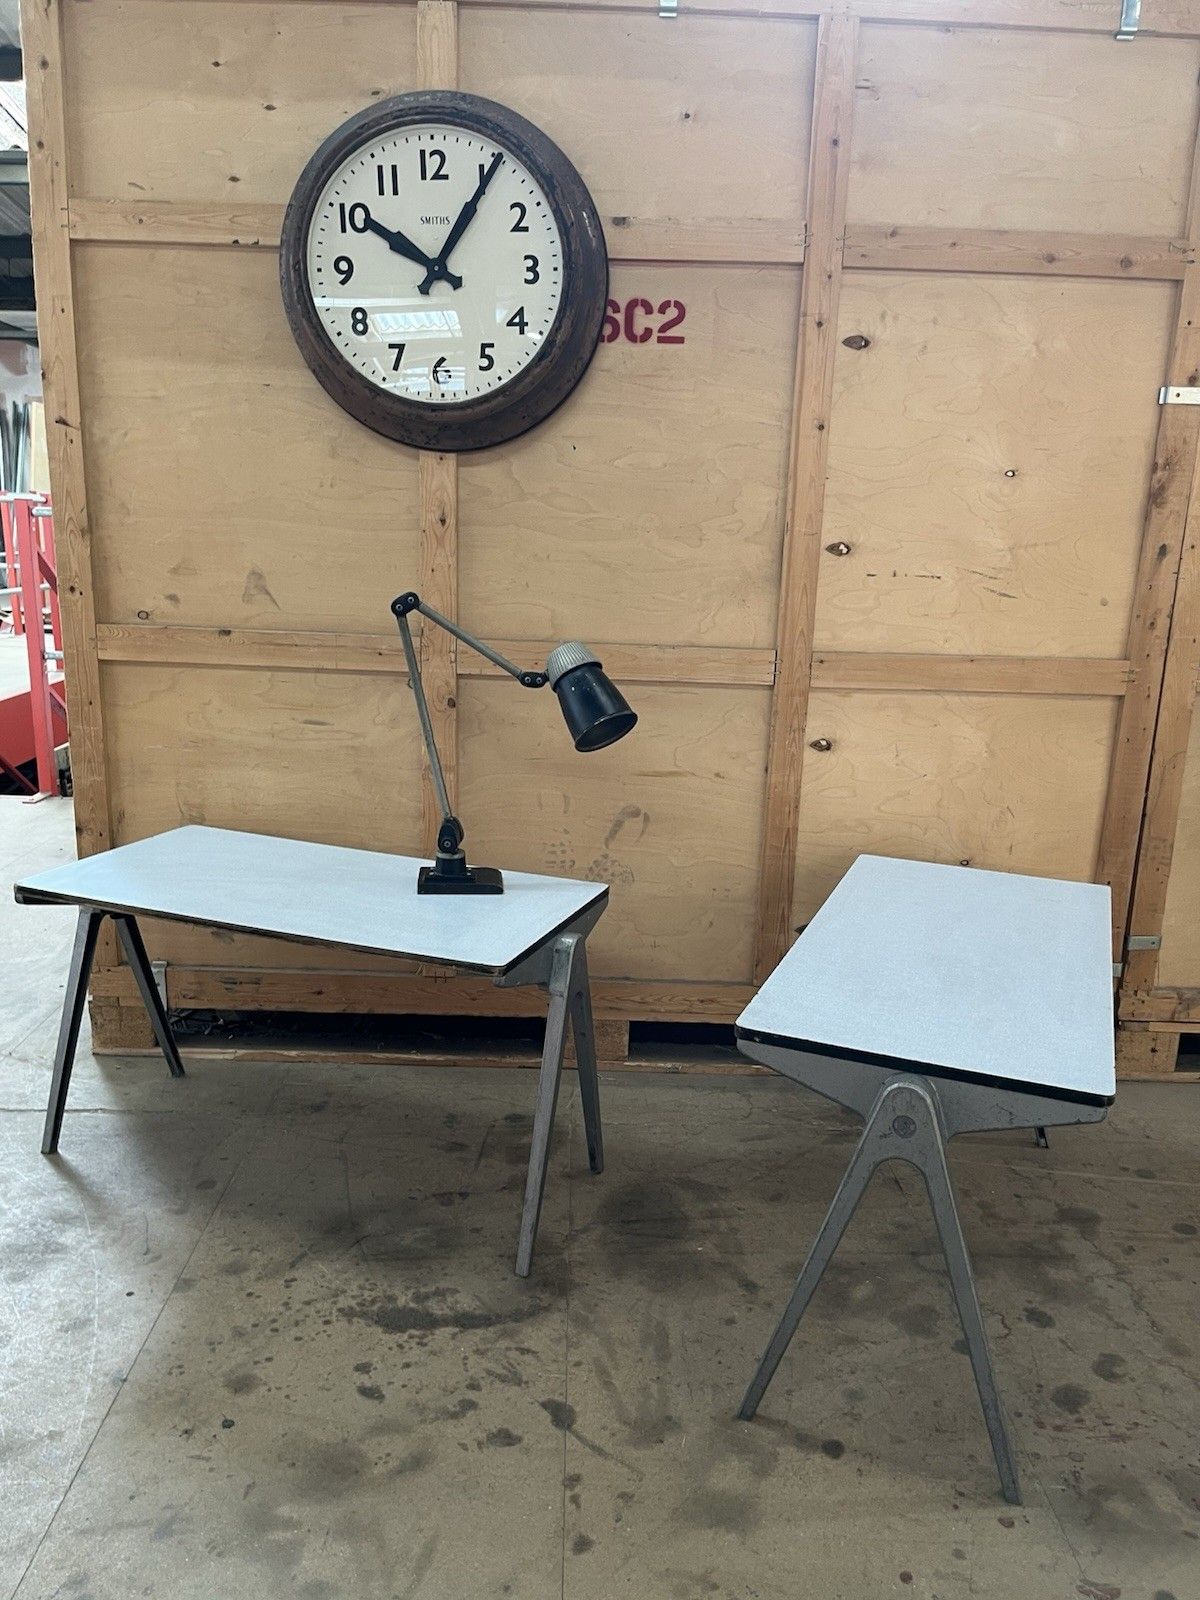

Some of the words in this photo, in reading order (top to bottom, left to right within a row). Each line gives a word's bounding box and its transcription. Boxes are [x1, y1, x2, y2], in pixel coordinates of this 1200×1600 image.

[419, 149, 449, 181] 12
[377, 164, 399, 196] 11
[339, 202, 371, 233] 10
[420, 216, 450, 225] SMITHS
[509, 202, 529, 232] 2
[333, 255, 354, 286] 9
[523, 254, 540, 285] 3
[351, 307, 369, 336] 8
[506, 306, 528, 335] 4
[387, 343, 406, 371] 7
[432, 356, 452, 385] 6
[478, 342, 495, 371] 5
